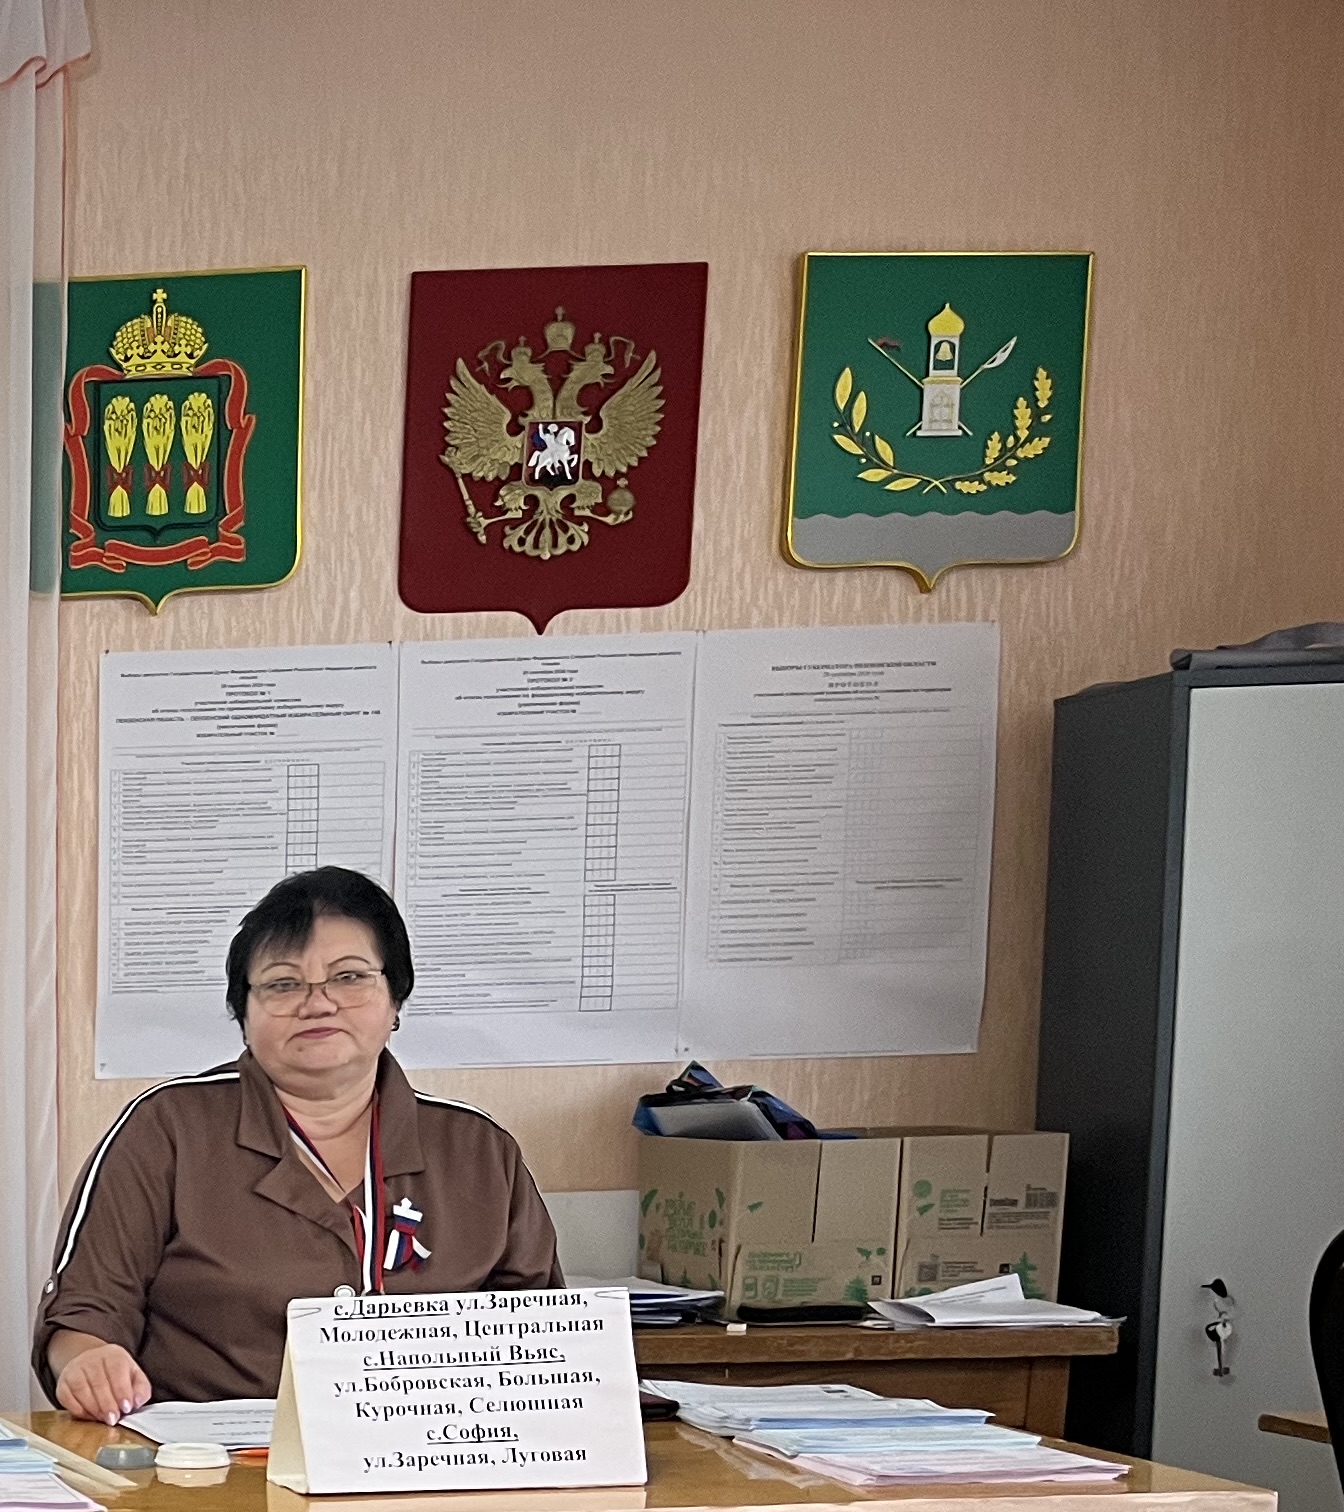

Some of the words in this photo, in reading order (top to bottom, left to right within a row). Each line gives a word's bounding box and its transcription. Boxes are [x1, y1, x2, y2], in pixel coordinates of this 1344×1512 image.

[334, 1298, 450, 1319] с.Дарьевка
[453, 1290, 588, 1314] ул.Заречная,
[319, 1326, 458, 1343] Молодежная,
[465, 1319, 604, 1340] Центральная
[364, 1346, 502, 1368] с.Напольный
[509, 1344, 566, 1364] Вьяс,
[334, 1375, 492, 1398] ул.Бобровская,
[498, 1370, 601, 1387] Большая,
[355, 1401, 463, 1422] Курочная,
[469, 1397, 584, 1414] Селюшная
[426, 1423, 520, 1446] с.София,
[363, 1451, 496, 1474] ул.Заречная,
[501, 1447, 587, 1468] Луговая
